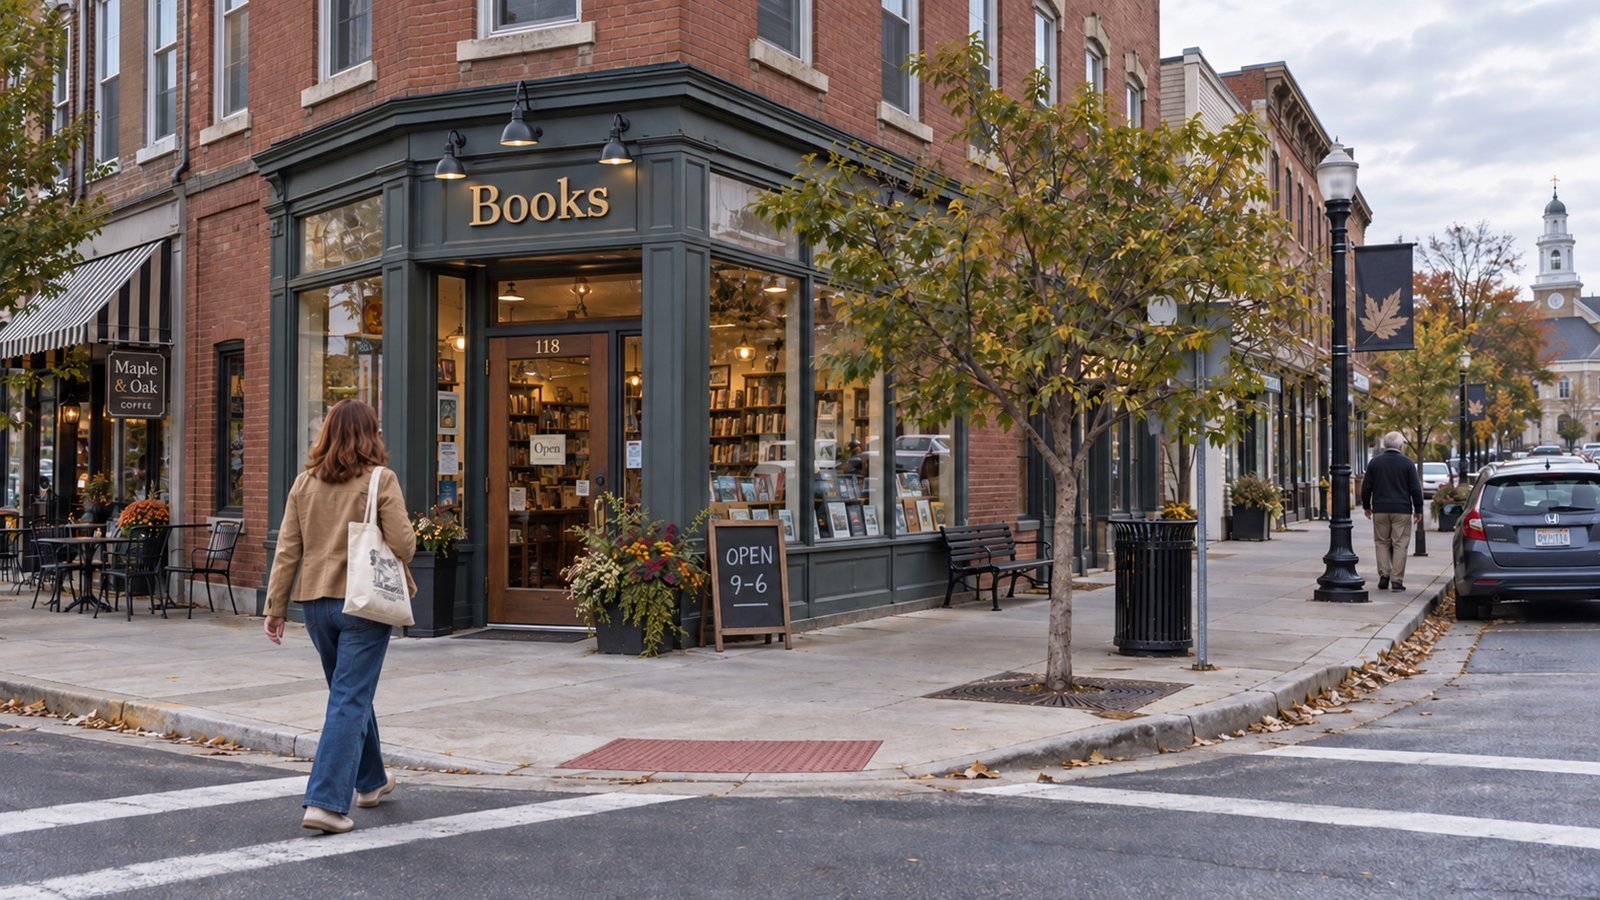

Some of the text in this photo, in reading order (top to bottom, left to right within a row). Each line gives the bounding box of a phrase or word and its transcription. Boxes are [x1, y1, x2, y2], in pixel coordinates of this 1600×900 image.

[469, 177, 609, 226] Books
[536, 339, 560, 354] 118
[115, 360, 158, 378] Maple
[114, 378, 158, 394] & Oak
[120, 402, 152, 410] COFFEE
[534, 442, 561, 456] Open
[726, 545, 773, 566] OPEN
[730, 573, 768, 596] 9-6
